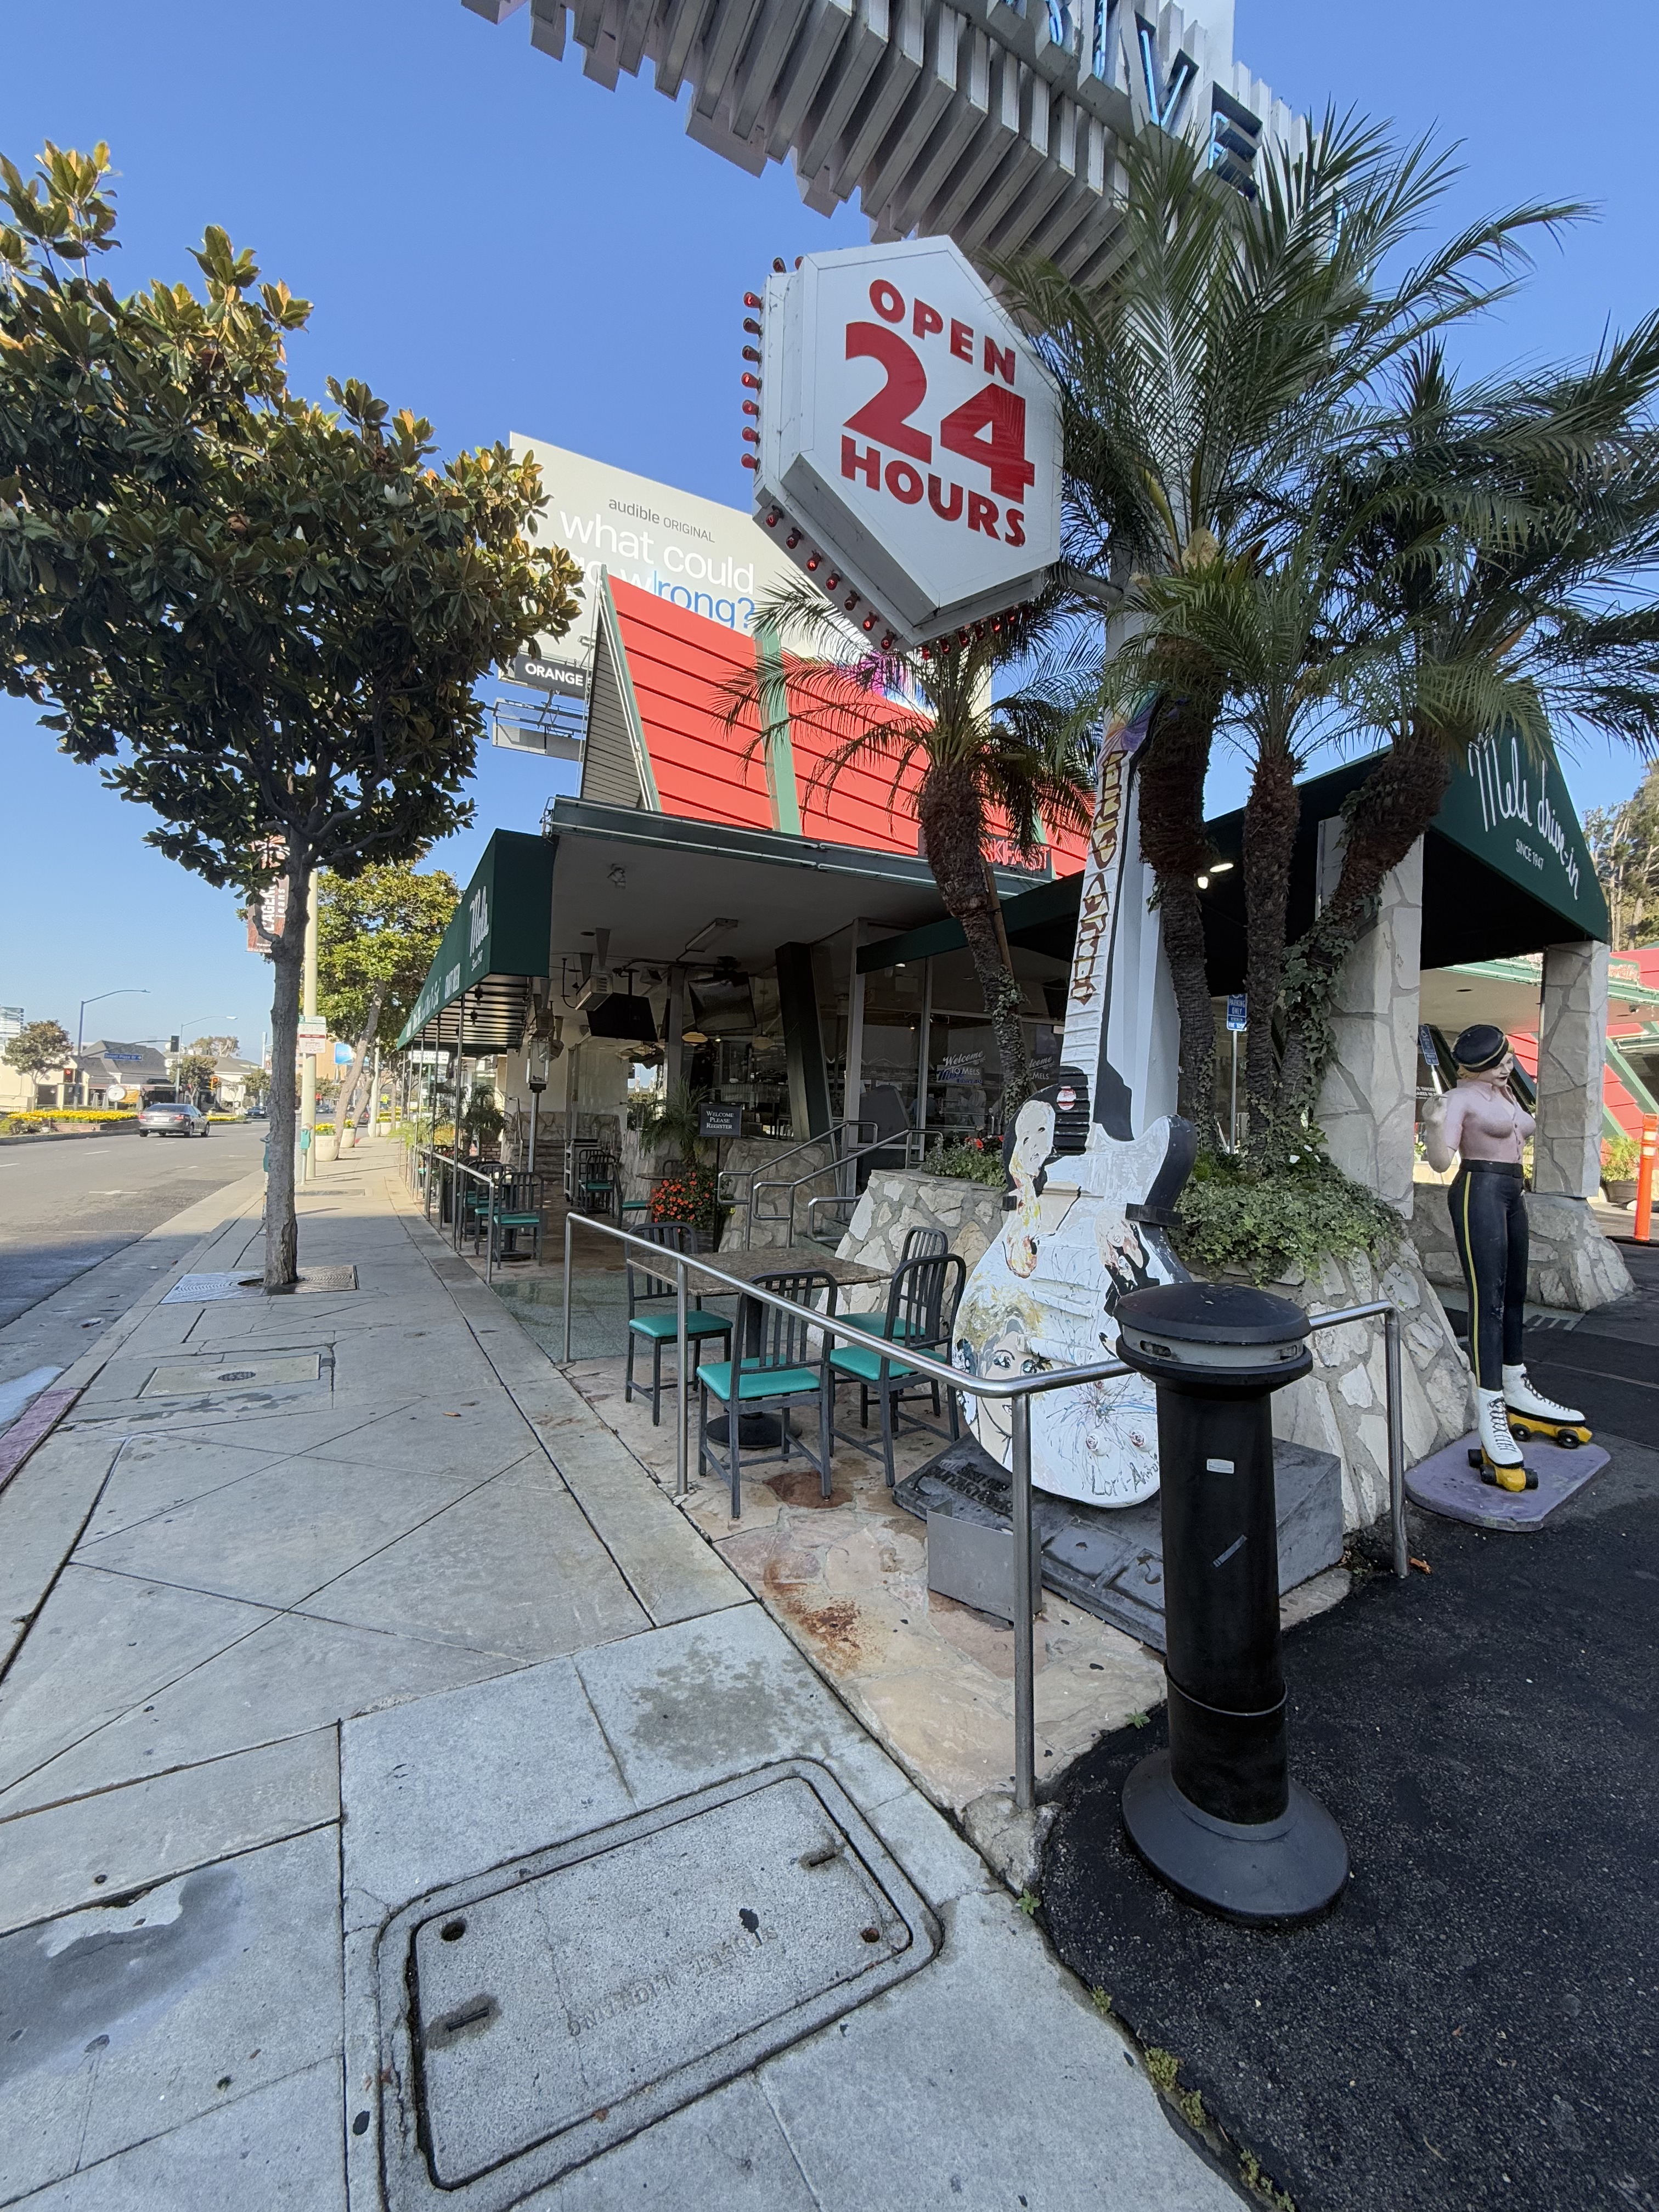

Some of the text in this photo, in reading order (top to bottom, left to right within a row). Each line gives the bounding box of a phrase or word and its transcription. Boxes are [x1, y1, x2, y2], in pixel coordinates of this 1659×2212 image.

[869, 279, 1016, 386] OPEN
[842, 320, 1035, 505] 24
[841, 434, 1026, 547] HOURS
[608, 498, 715, 544] audible ORIGINAL
[559, 510, 754, 595] what could
[525, 663, 584, 687] ORANGE
[1468, 727, 1533, 833] Mels
[1516, 838, 1544, 871] SINCE 1947
[261, 880, 276, 932] L'AGEN
[275, 888, 286, 918] jeans
[942, 1050, 984, 1067] Welcome
[951, 1066, 981, 1076] TO MELS
[1032, 1071, 1049, 1081] MELS
